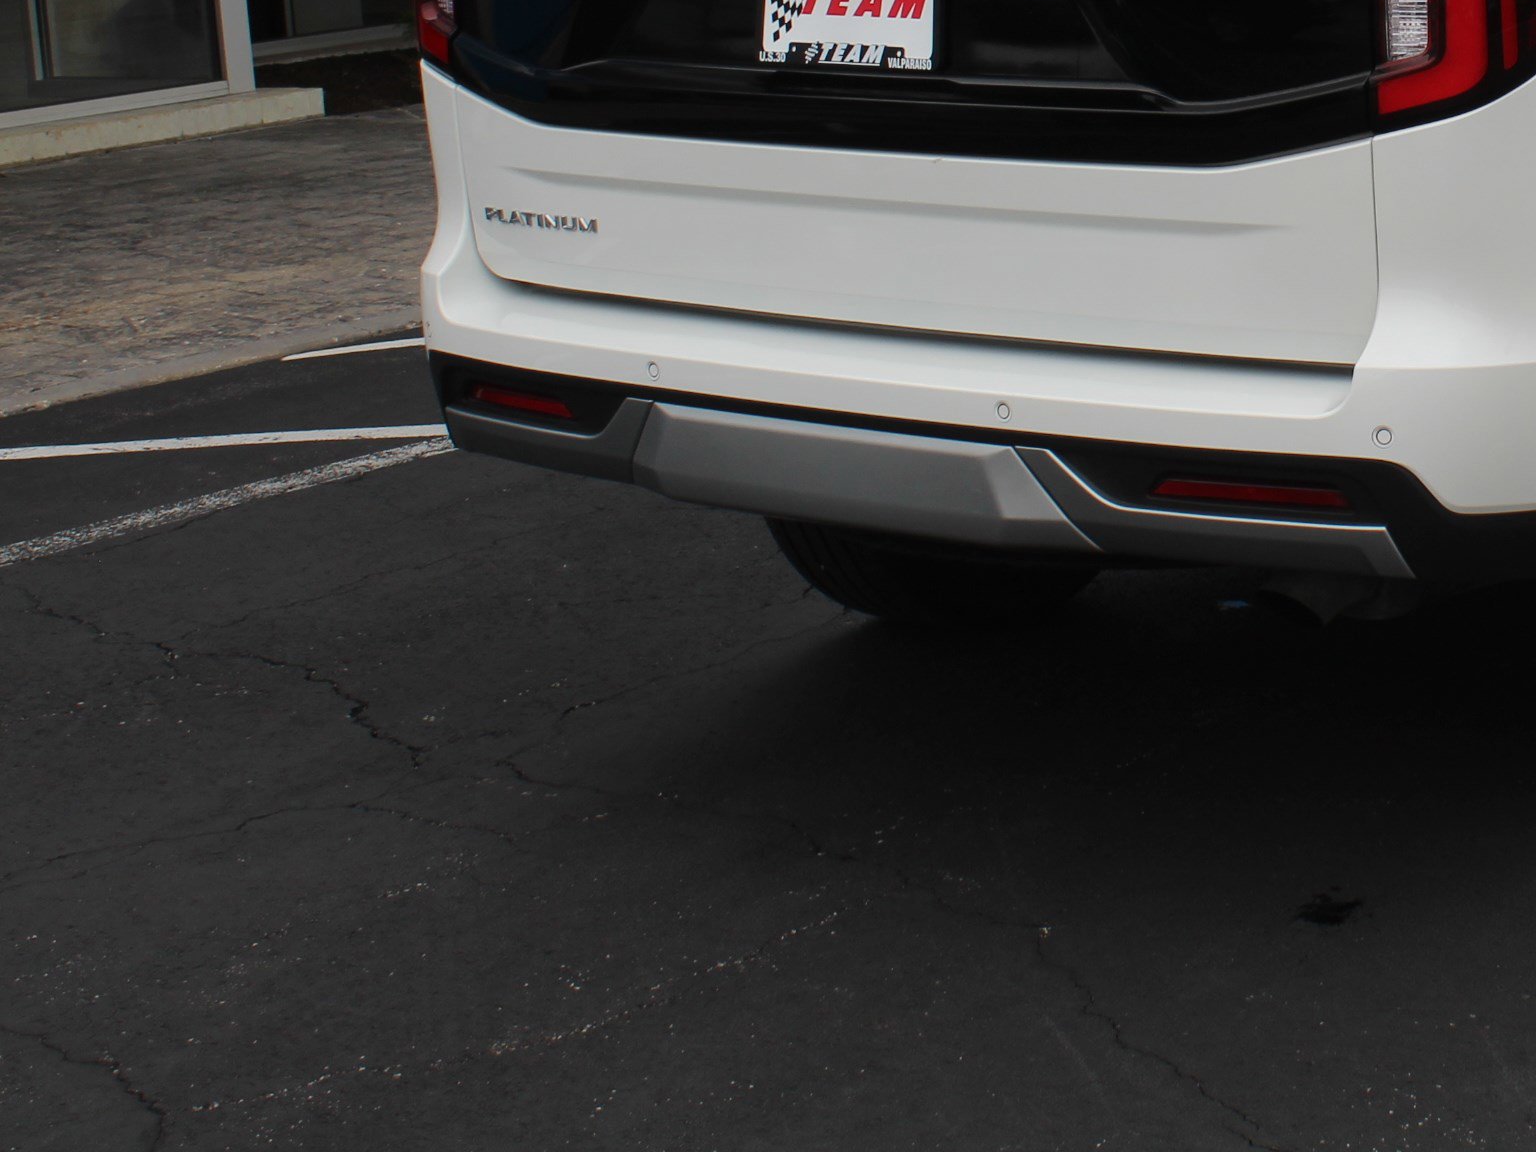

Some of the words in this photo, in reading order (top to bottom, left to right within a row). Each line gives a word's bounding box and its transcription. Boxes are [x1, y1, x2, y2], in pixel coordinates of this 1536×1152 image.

[818, 42, 886, 65] TEAM
[887, 57, 932, 71] VALPARAISO
[485, 207, 599, 233] PLATINUM
